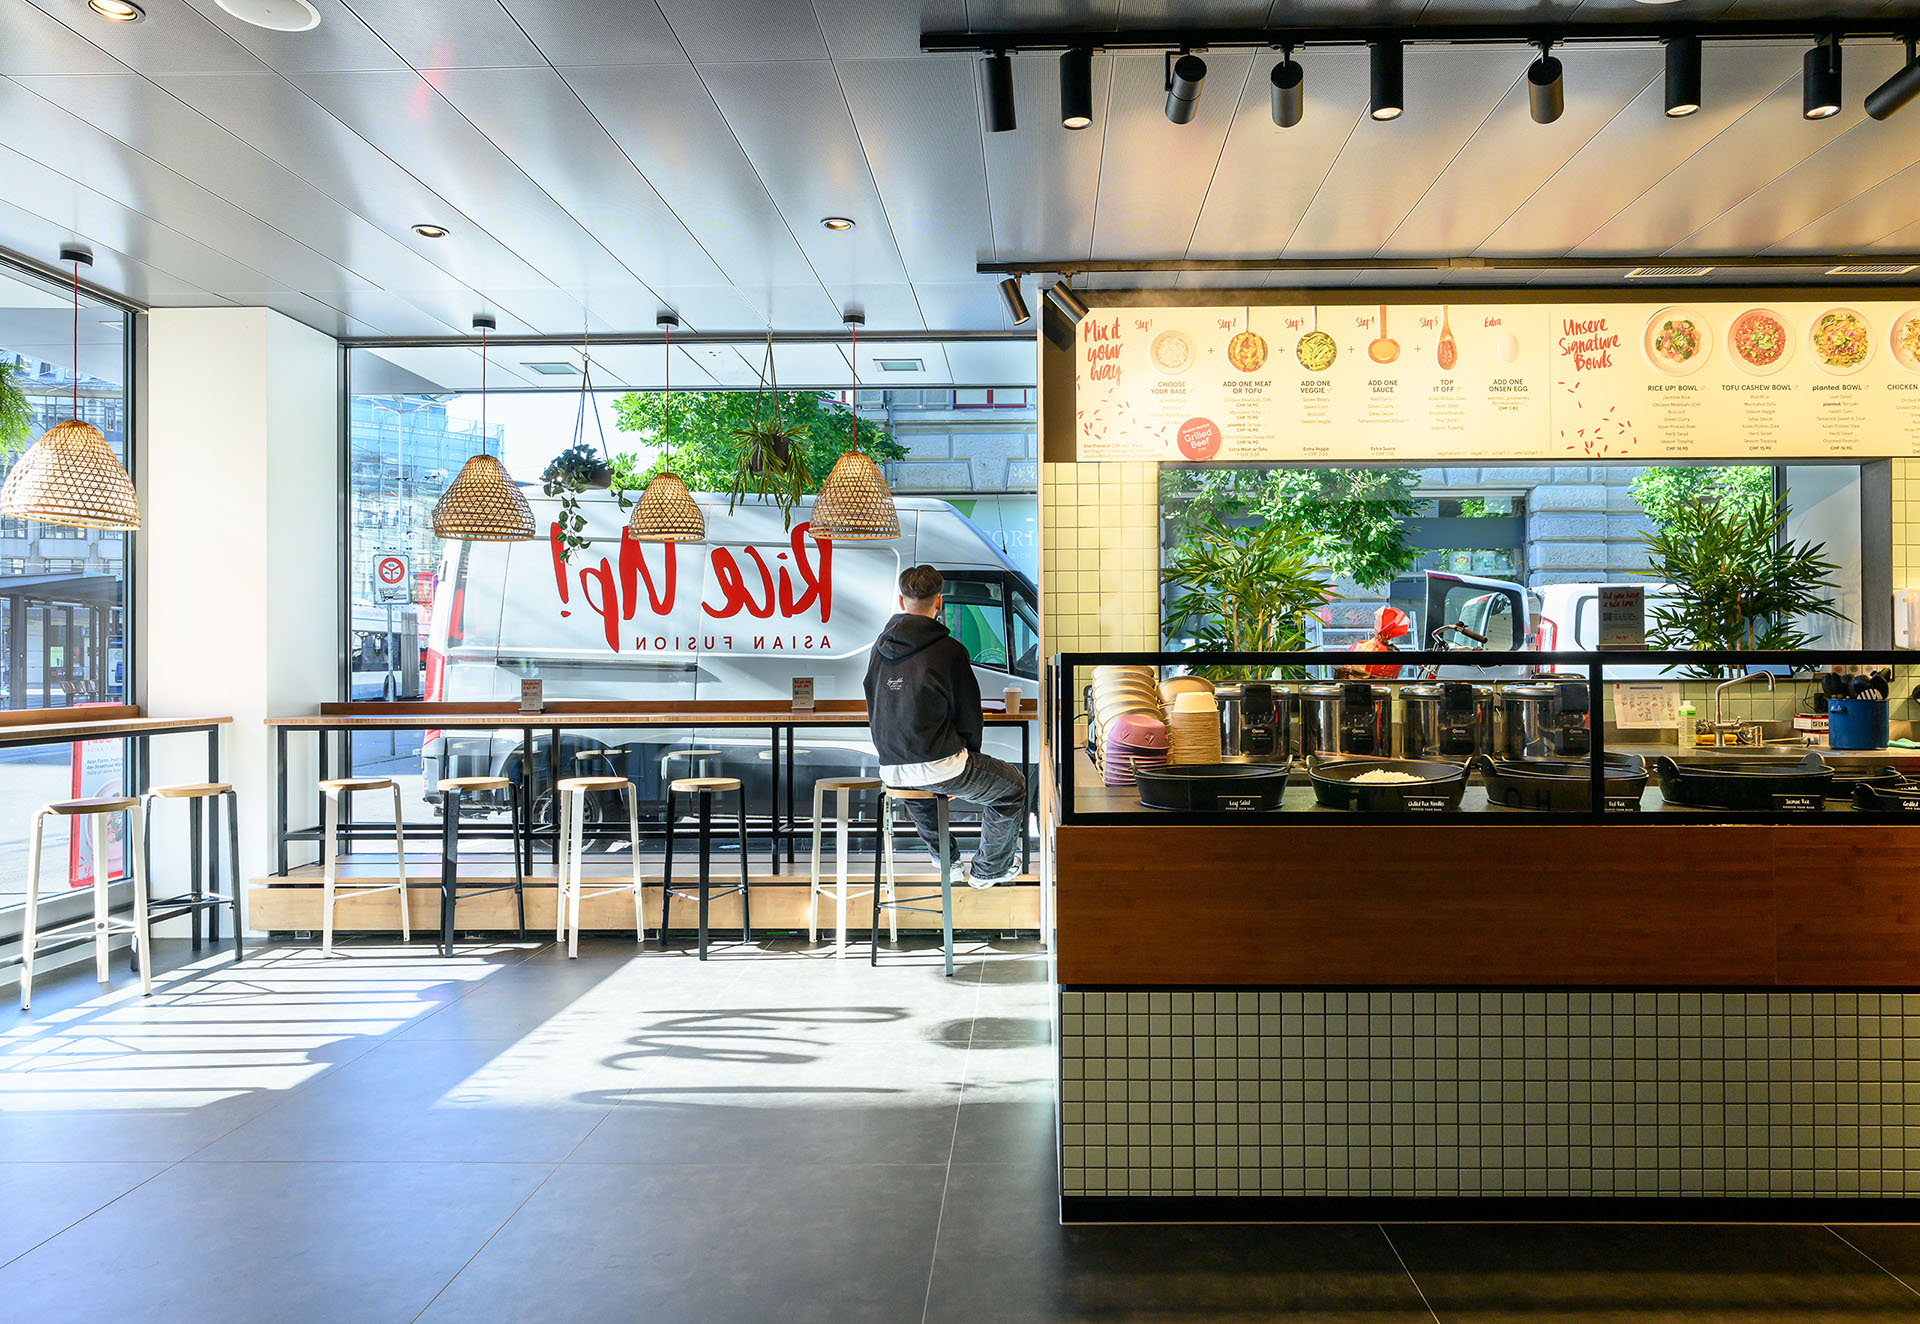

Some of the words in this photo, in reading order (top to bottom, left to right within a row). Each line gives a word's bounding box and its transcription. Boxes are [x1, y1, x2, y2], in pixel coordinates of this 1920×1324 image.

[1084, 320, 1109, 342] Mix
[1111, 316, 1120, 339] it
[1484, 316, 1502, 328] Extra
[1563, 318, 1608, 336] Unsere
[1088, 344, 1124, 368] your
[1558, 334, 1621, 358] Signature
[1574, 350, 1612, 372] Bowls
[1090, 364, 1123, 386] way
[1184, 428, 1212, 442] Grilled
[1190, 437, 1209, 448] Beef
